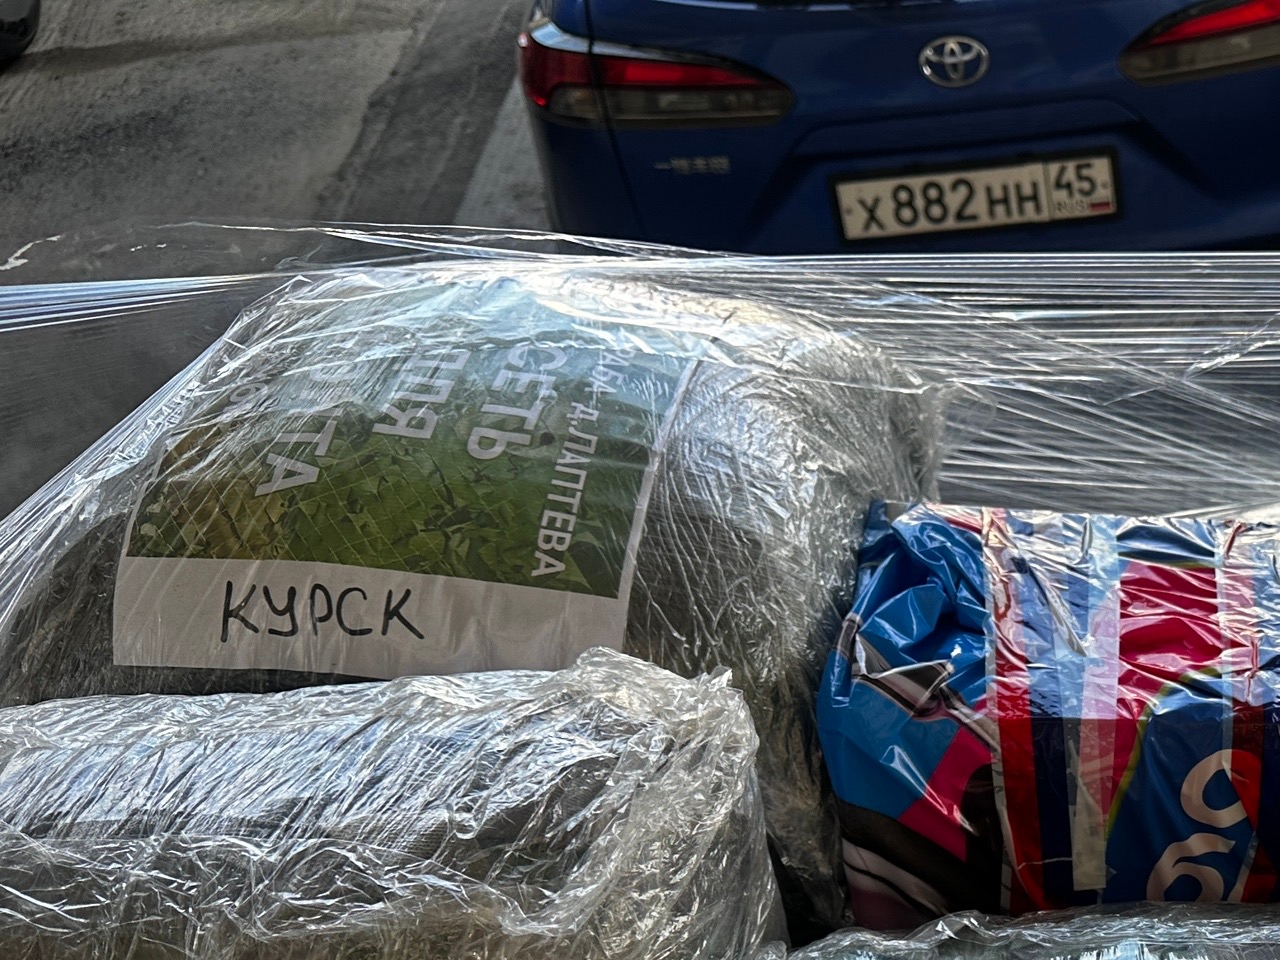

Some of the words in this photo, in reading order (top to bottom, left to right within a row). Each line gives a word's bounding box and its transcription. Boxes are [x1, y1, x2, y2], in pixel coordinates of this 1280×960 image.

[1054, 163, 1097, 197] 45
[466, 344, 568, 460] СЕТЬ
[220, 580, 425, 643] КУРСК
